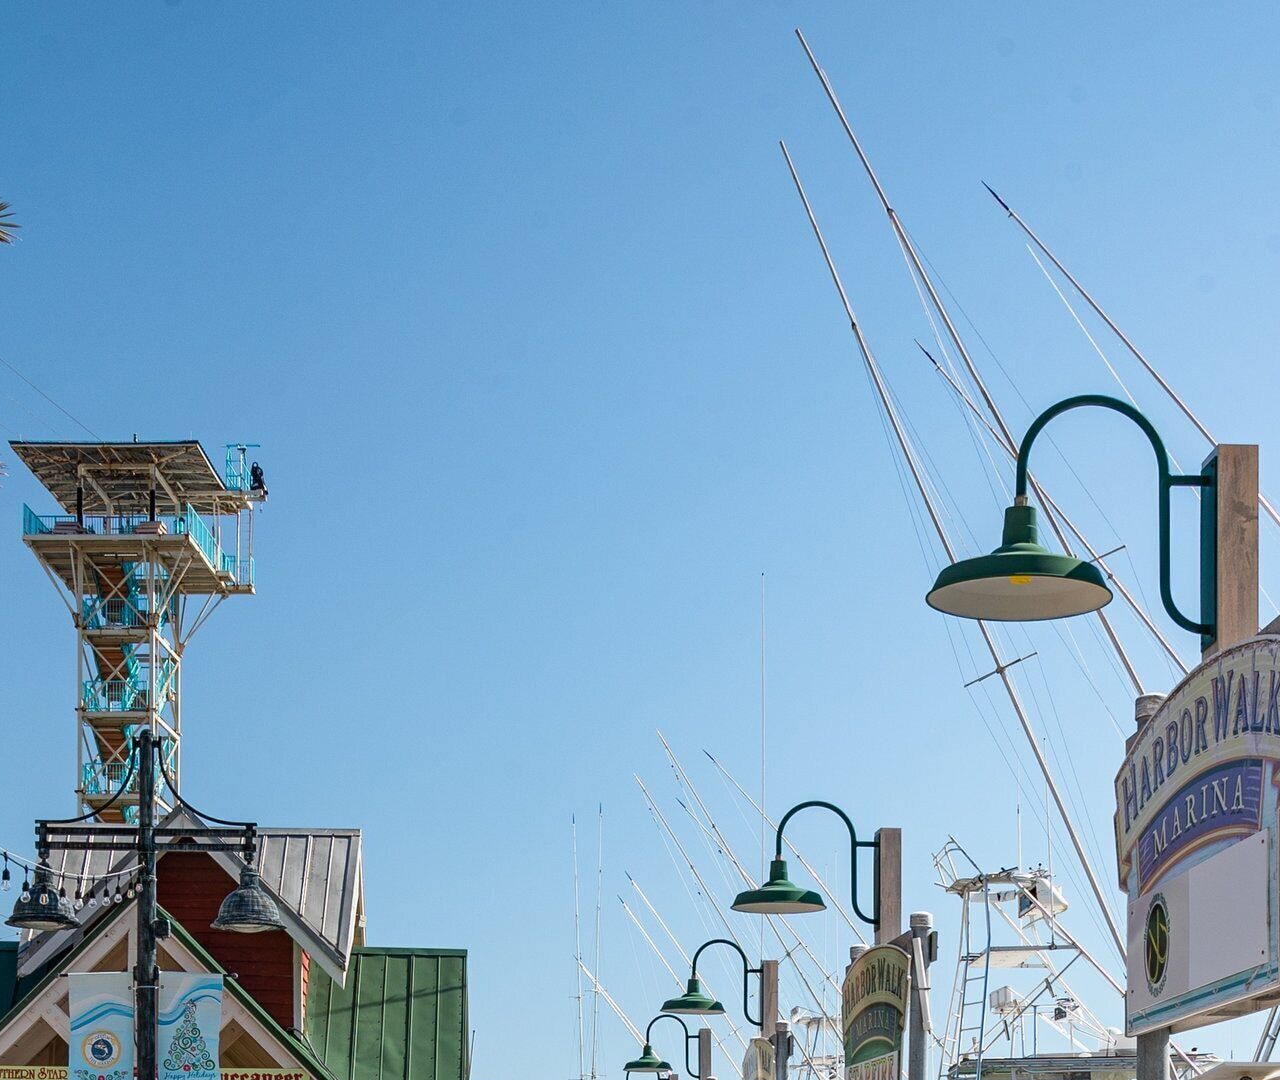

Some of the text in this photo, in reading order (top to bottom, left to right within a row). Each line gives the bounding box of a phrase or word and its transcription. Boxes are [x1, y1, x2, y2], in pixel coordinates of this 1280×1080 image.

[1153, 774, 1245, 861] MARINA
[855, 1009, 890, 1040] MARINA
[37, 1066, 68, 1080] STAR
[187, 1070, 216, 1080] Holidays
